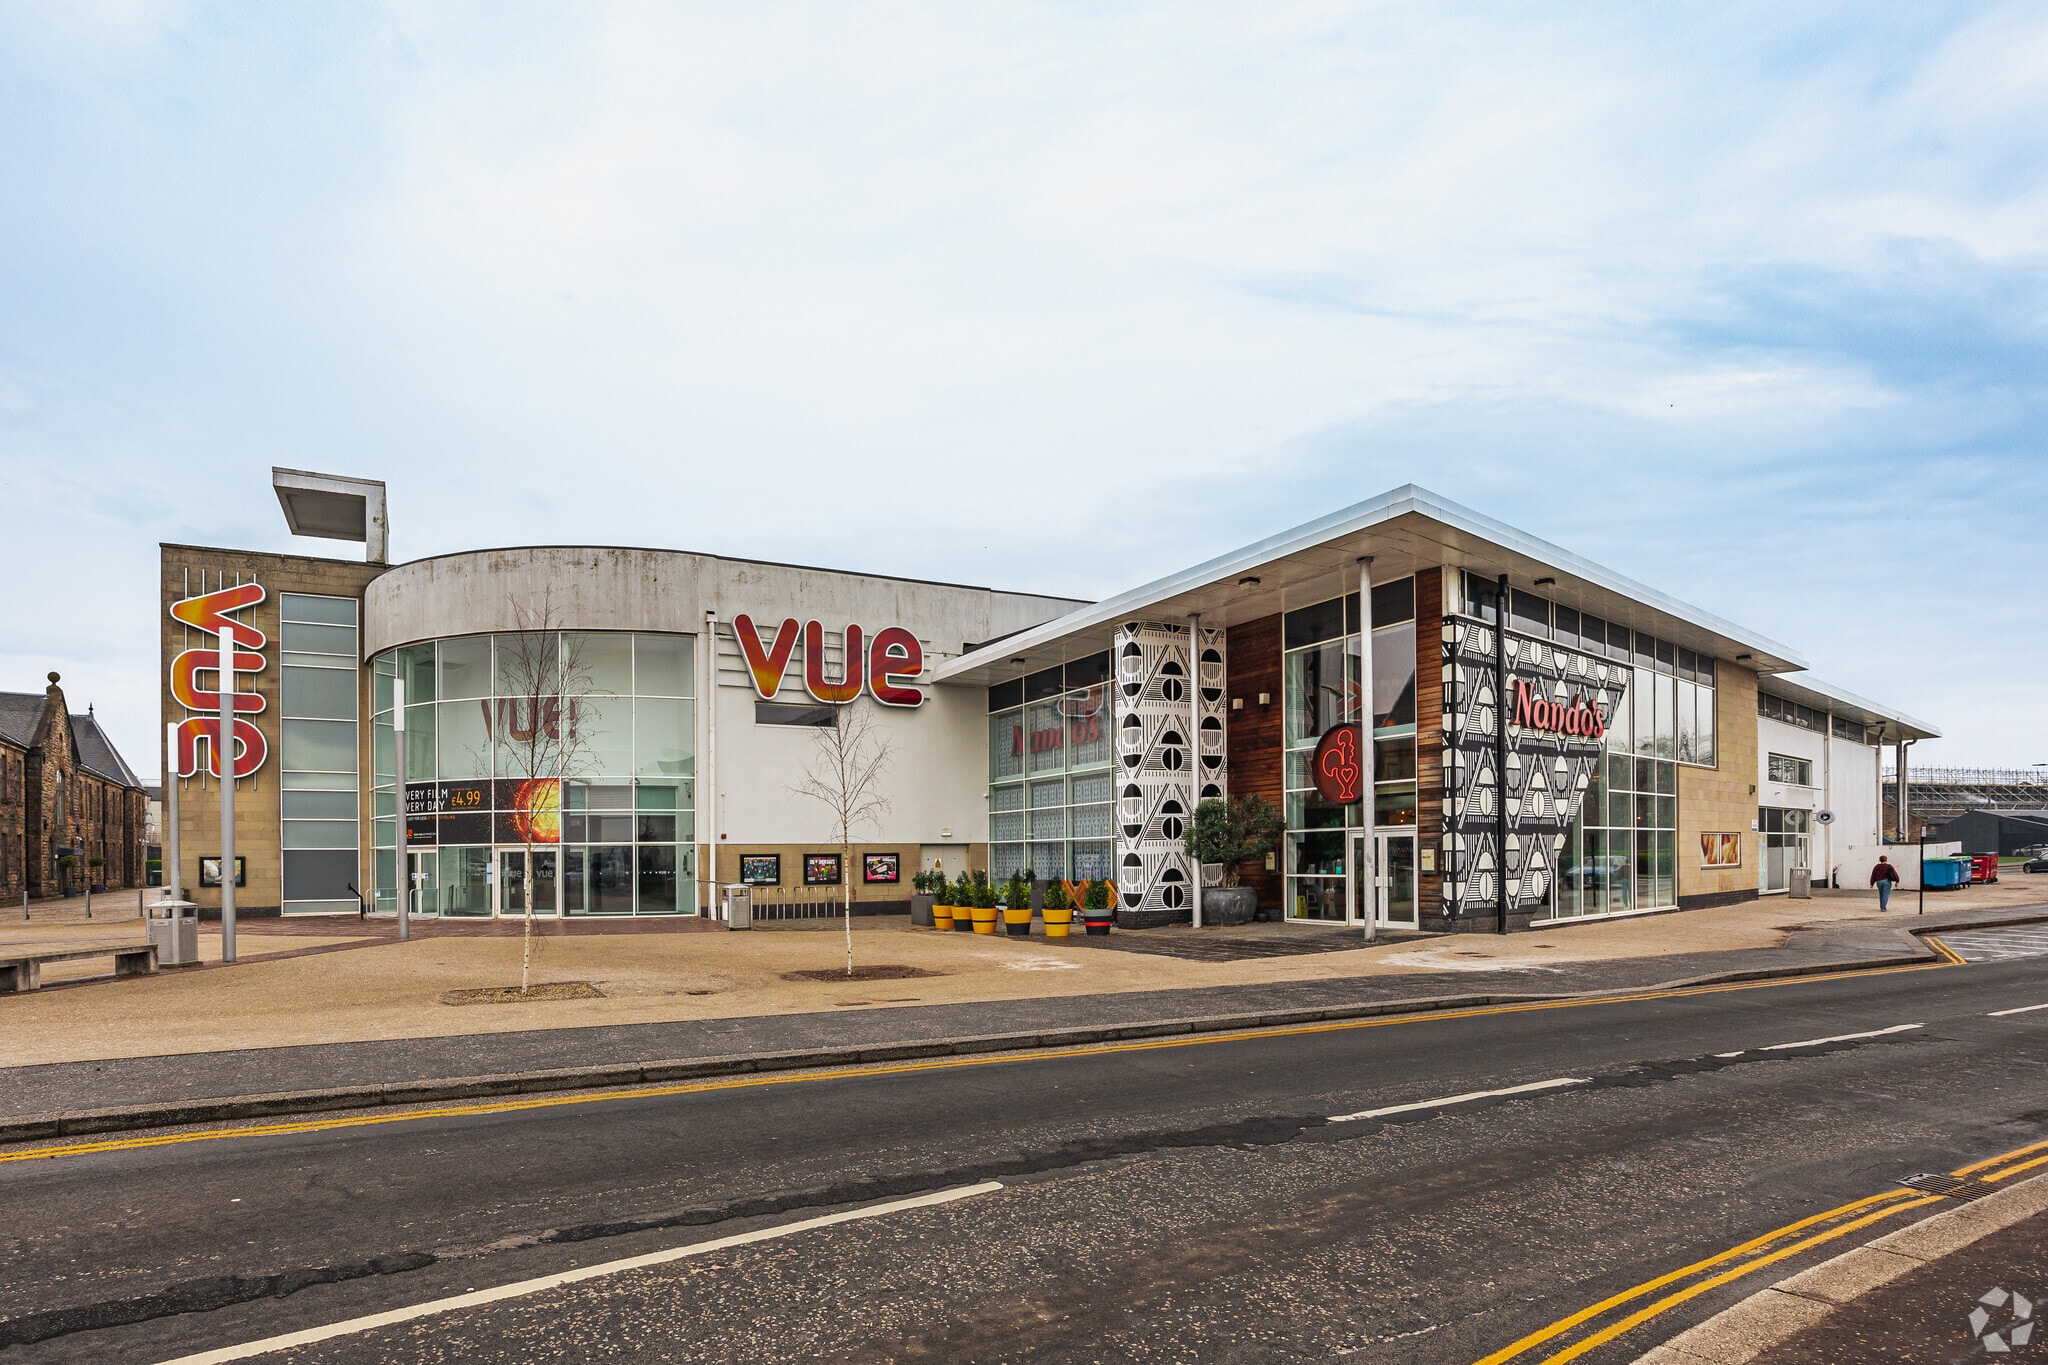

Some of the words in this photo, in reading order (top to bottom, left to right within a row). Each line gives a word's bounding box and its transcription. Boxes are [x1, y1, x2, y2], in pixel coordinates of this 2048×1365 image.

[1513, 679, 1605, 739] Nando's
[405, 789, 425, 801] VERY
[451, 790, 481, 806] £4.99
[405, 801, 425, 812] VERY
[427, 800, 446, 811] DAY
